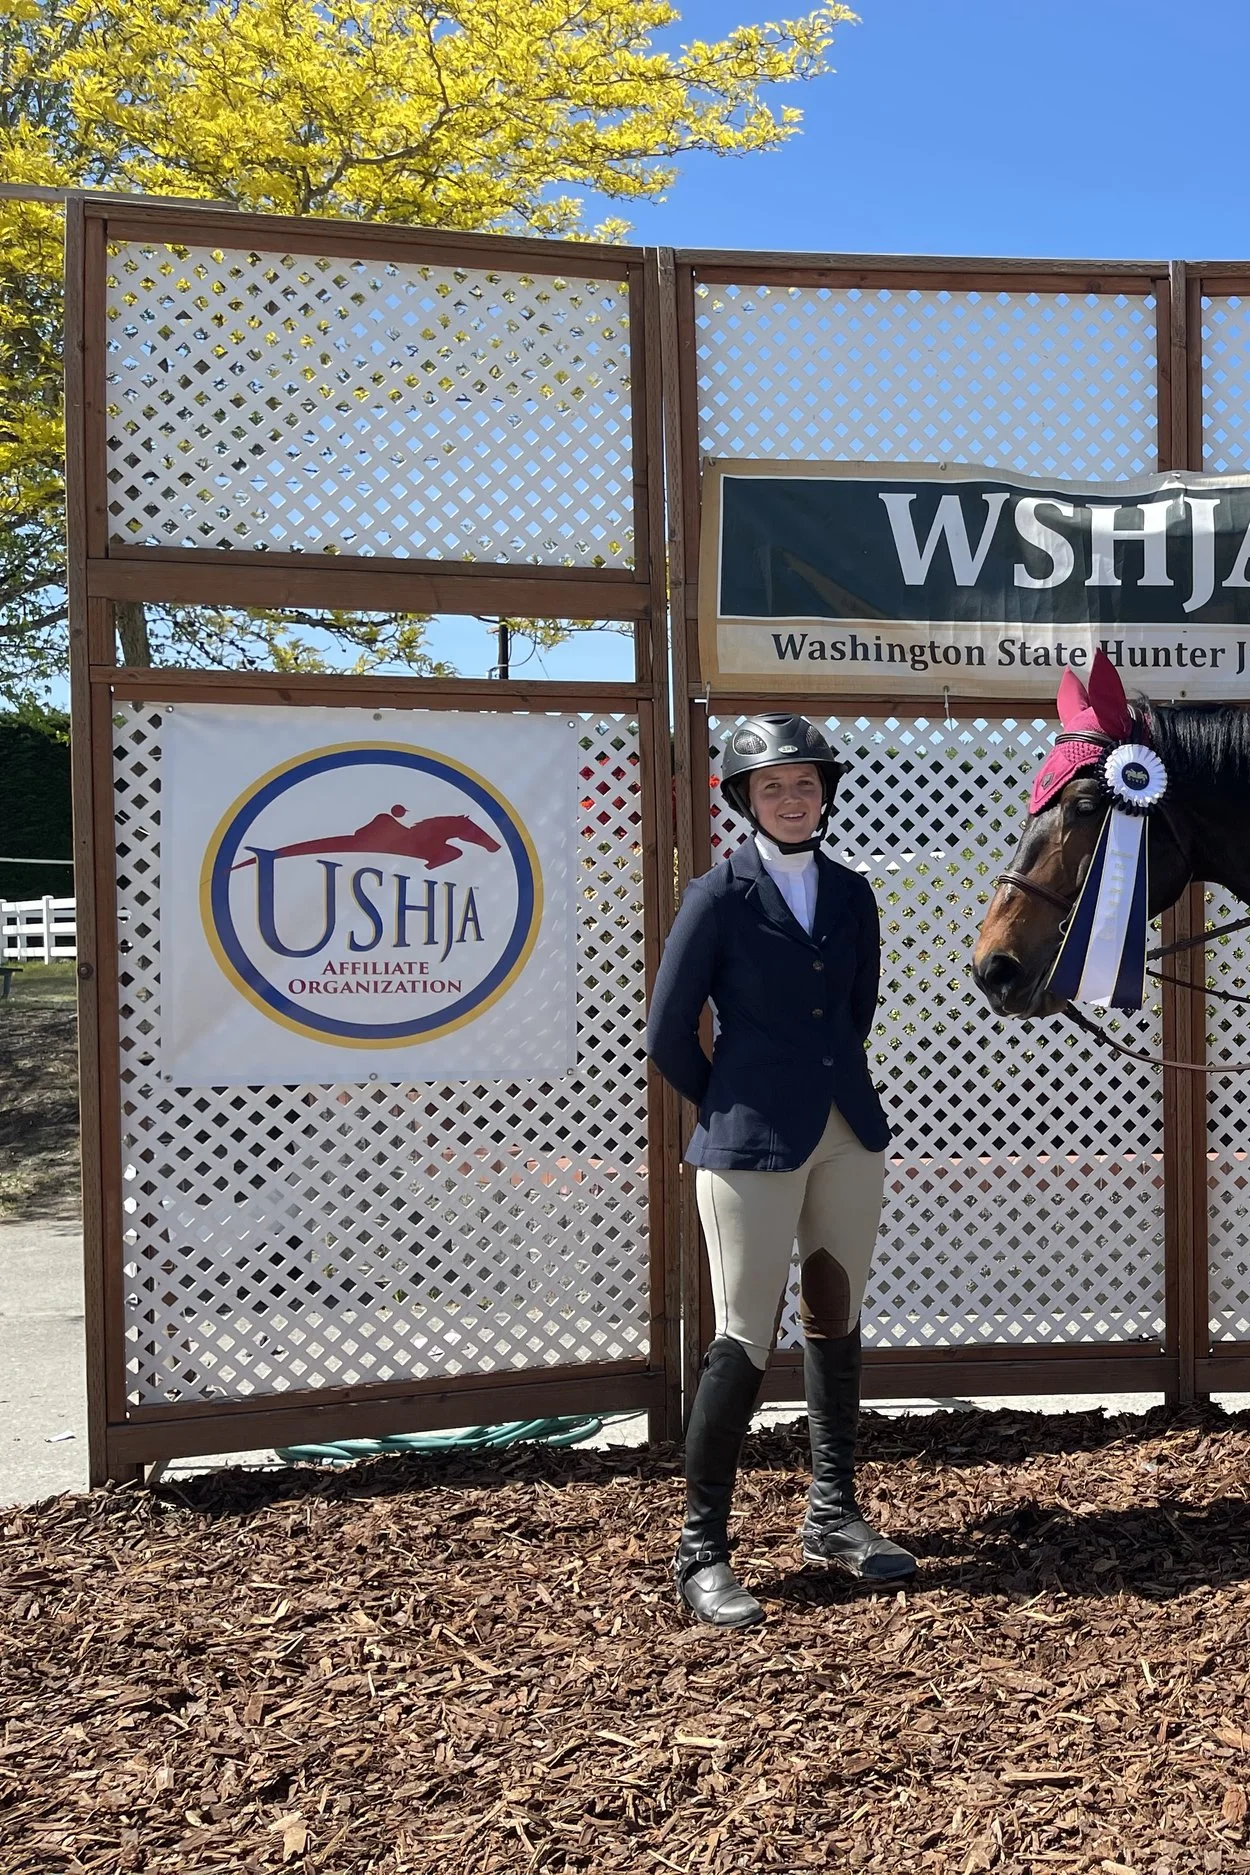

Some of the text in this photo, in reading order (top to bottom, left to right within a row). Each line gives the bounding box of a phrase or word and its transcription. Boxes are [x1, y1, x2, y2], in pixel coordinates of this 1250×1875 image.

[771, 633, 986, 671] Washington
[998, 638, 1087, 667] State
[1100, 639, 1226, 668] Hunter
[244, 846, 485, 963] USHJA
[321, 959, 430, 976] AFFILIATE
[287, 978, 462, 995] ORGANIZATION
